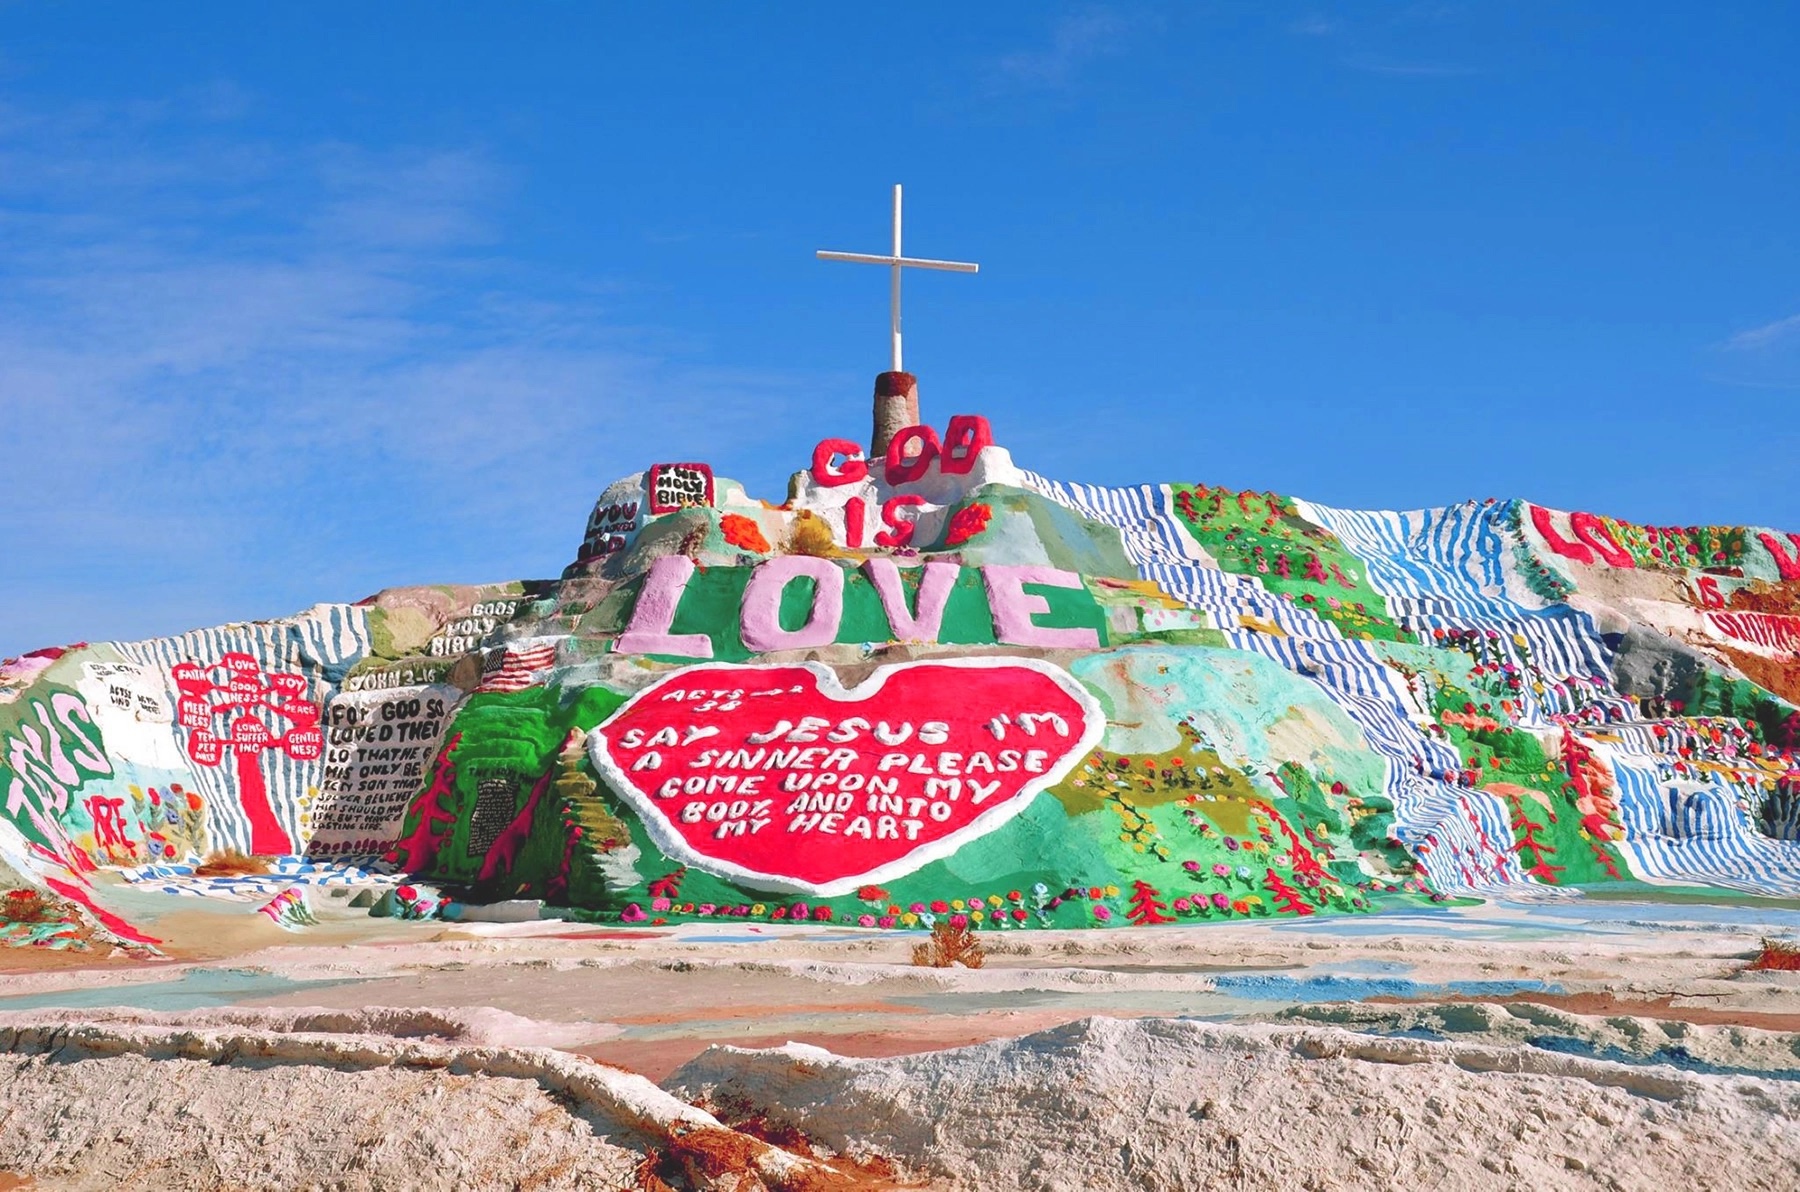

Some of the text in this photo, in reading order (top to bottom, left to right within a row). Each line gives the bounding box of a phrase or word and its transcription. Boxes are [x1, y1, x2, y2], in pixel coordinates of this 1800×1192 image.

[811, 415, 994, 488] GOD
[658, 477, 703, 493] HOLY
[594, 502, 638, 526] YOU
[845, 494, 915, 549] IS
[611, 555, 1101, 658] LOVE
[227, 657, 257, 671] LOVE
[177, 668, 207, 681] FAITH
[350, 670, 400, 691] JOHN
[229, 680, 259, 692] GOOD
[277, 678, 305, 691] JOY
[229, 693, 259, 703] NESS
[662, 688, 745, 702] ACTS
[183, 701, 211, 716] MEEK
[284, 703, 316, 715] PEACE
[426, 699, 446, 719] SO
[183, 714, 210, 729] NESS
[235, 732, 269, 743] SUFFER
[330, 724, 394, 747] LOVED
[619, 712, 1070, 749] SAY JESUS I'M
[288, 733, 321, 744] GENTLE
[197, 743, 217, 753] PER
[290, 745, 318, 756] NESS
[630, 746, 1049, 776] A SINNER PLEASE
[359, 763, 402, 779] ONLY
[357, 779, 388, 792] SON
[659, 773, 1002, 805] COME UPON MY
[339, 804, 385, 815] SHOULD
[785, 791, 854, 816] AND
[866, 794, 952, 822] INTO
[714, 812, 924, 840] MY HEART
